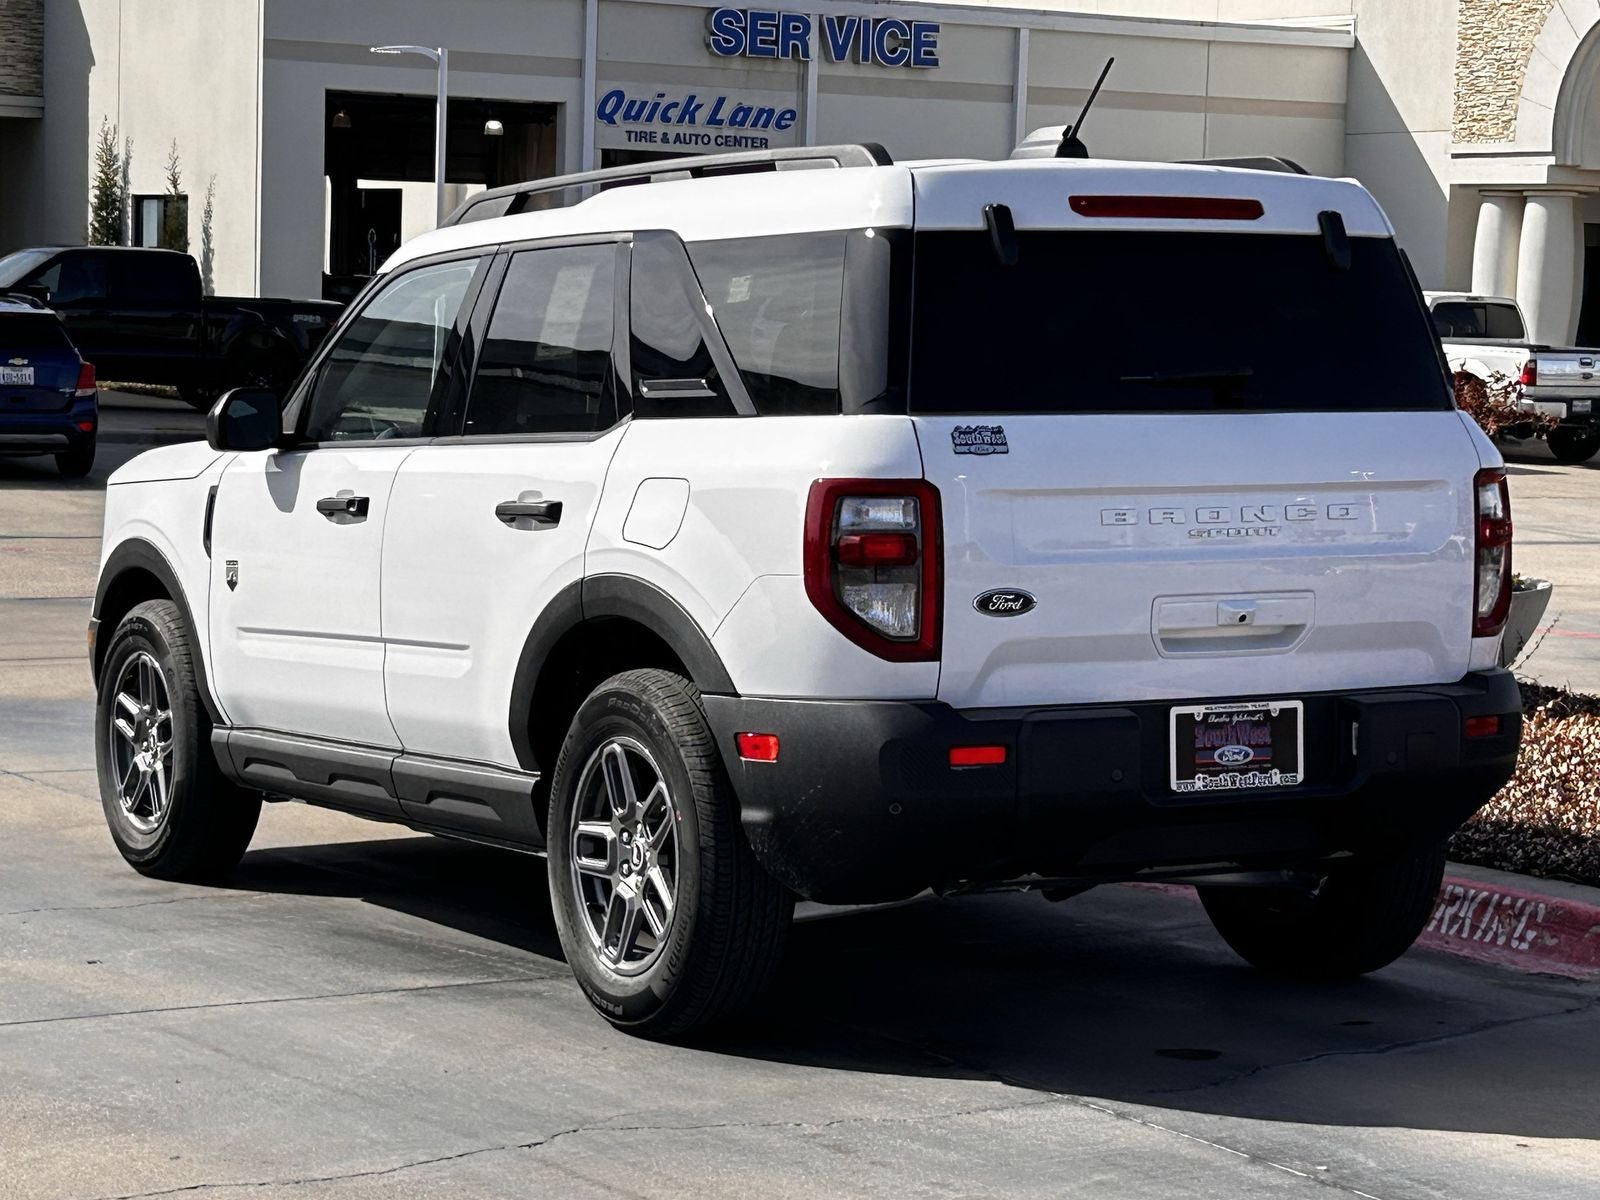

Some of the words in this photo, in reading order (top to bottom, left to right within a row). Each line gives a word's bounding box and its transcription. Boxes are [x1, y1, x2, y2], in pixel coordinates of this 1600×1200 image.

[709, 8, 941, 68] SERVICE
[596, 89, 703, 127] Quick
[706, 96, 797, 131] Lane
[625, 130, 658, 145] TIRE
[660, 132, 670, 145] &
[673, 132, 712, 147] AUTO
[714, 134, 769, 149] CENTER
[1100, 504, 1362, 526] BRONCO
[1187, 525, 1281, 538] SPORT
[988, 594, 1024, 610] Ford
